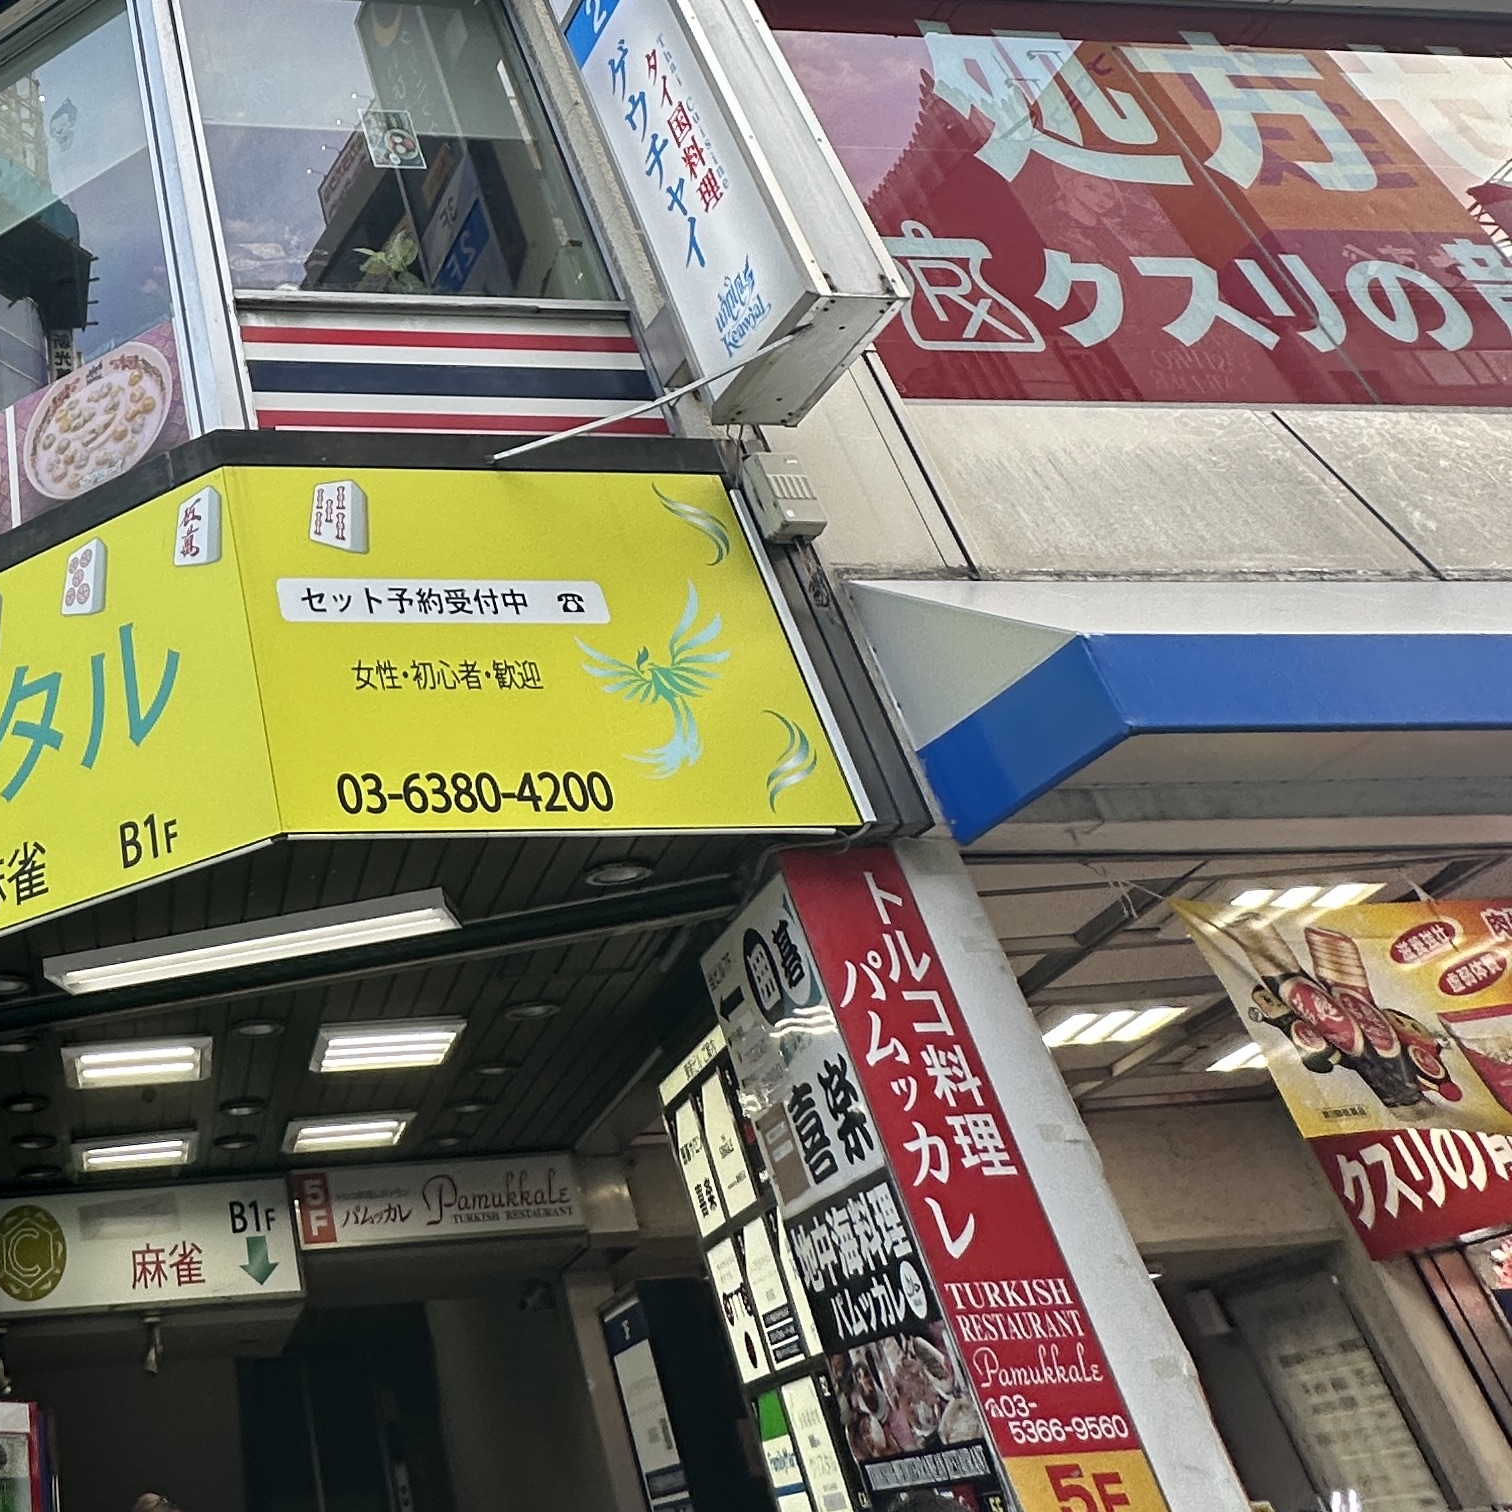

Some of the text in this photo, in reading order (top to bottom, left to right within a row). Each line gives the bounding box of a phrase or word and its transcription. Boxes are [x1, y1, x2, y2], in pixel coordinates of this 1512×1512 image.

[645, 47, 725, 215] タイ国料理
[655, 32, 730, 191] Thai Cuisine
[607, 37, 706, 270] ゲウチャイ
[302, 588, 528, 616] セット予約受付中
[353, 659, 544, 691] 女性・初心者・歓迎
[337, 770, 614, 815] 03-6380-4200
[120, 813, 178, 869] B1F
[863, 871, 1018, 1177] トルコ料理
[840, 949, 975, 1260] パムッカレ
[229, 1200, 276, 1236] B1F
[342, 1203, 413, 1228] パムッカレ
[422, 1168, 571, 1226] Pamukkale
[452, 1205, 574, 1225] TURKISH RESTAURANT
[790, 1182, 914, 1294] 地中海料理
[130, 1240, 206, 1291] 麻雀
[830, 1276, 905, 1341] パムッカレ
[944, 1278, 1074, 1310] TURKISH
[956, 1309, 1085, 1343] RESTAURANT
[972, 1343, 1104, 1389] Pamukkale
[1009, 1414, 1129, 1444] 5366-9560
[1044, 1462, 1131, 1512] 5F
